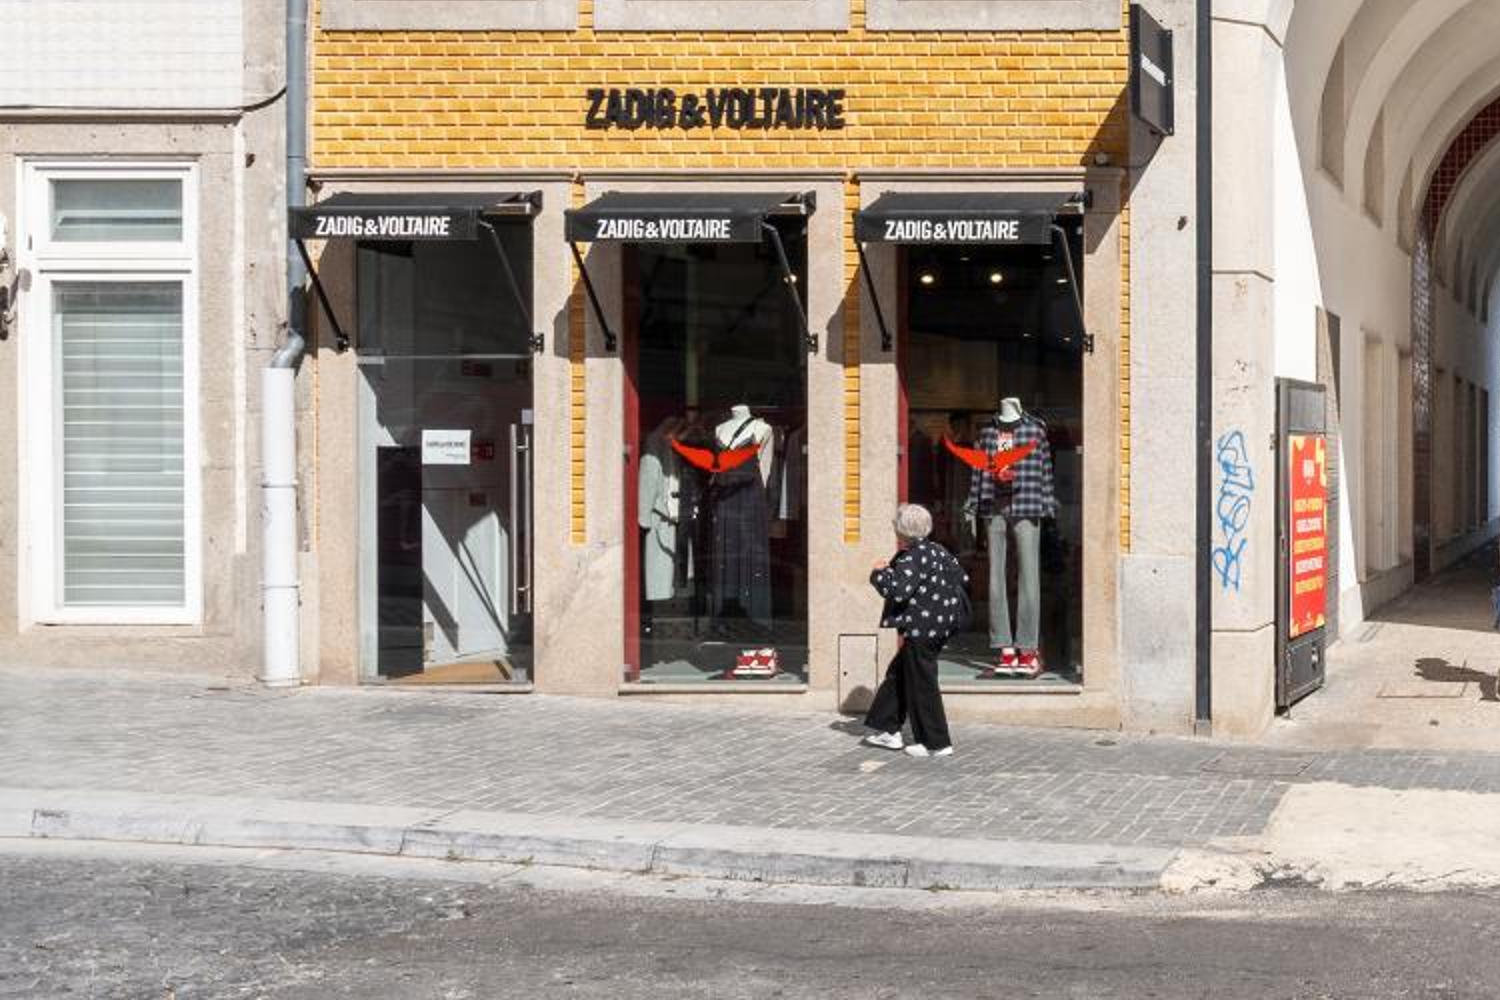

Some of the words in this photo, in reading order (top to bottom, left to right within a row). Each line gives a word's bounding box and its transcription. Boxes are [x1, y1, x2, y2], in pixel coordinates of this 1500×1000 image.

[586, 88, 846, 131] ZADIG&VOLTAIRE
[315, 215, 451, 237] ZADIG&VOLTAIRE
[596, 218, 731, 239] ZADIG&VOLTAIRE
[884, 219, 1020, 241] ZADIG&VOLTAIRE
